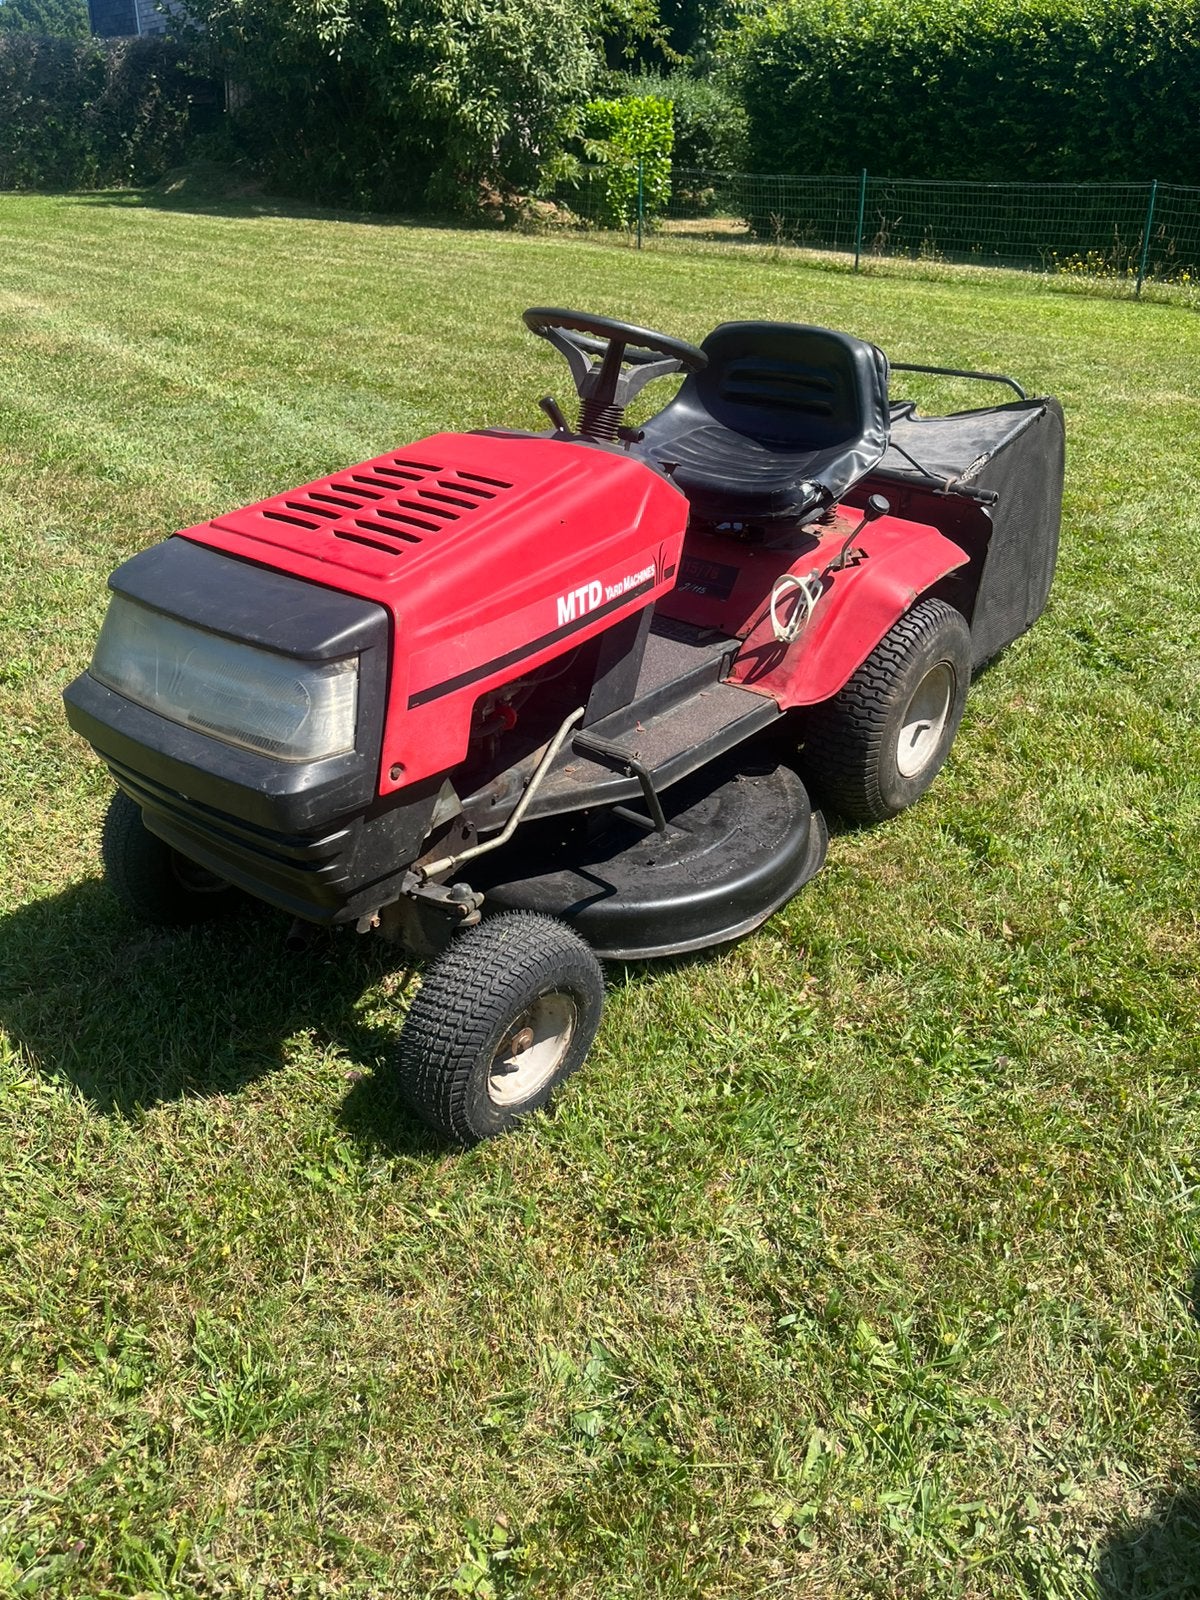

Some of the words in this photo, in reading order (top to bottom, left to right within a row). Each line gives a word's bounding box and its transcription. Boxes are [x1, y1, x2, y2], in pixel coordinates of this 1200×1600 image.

[556, 580, 603, 627] MTD
[605, 581, 624, 600] YARD
[623, 563, 655, 592] MACHINES
